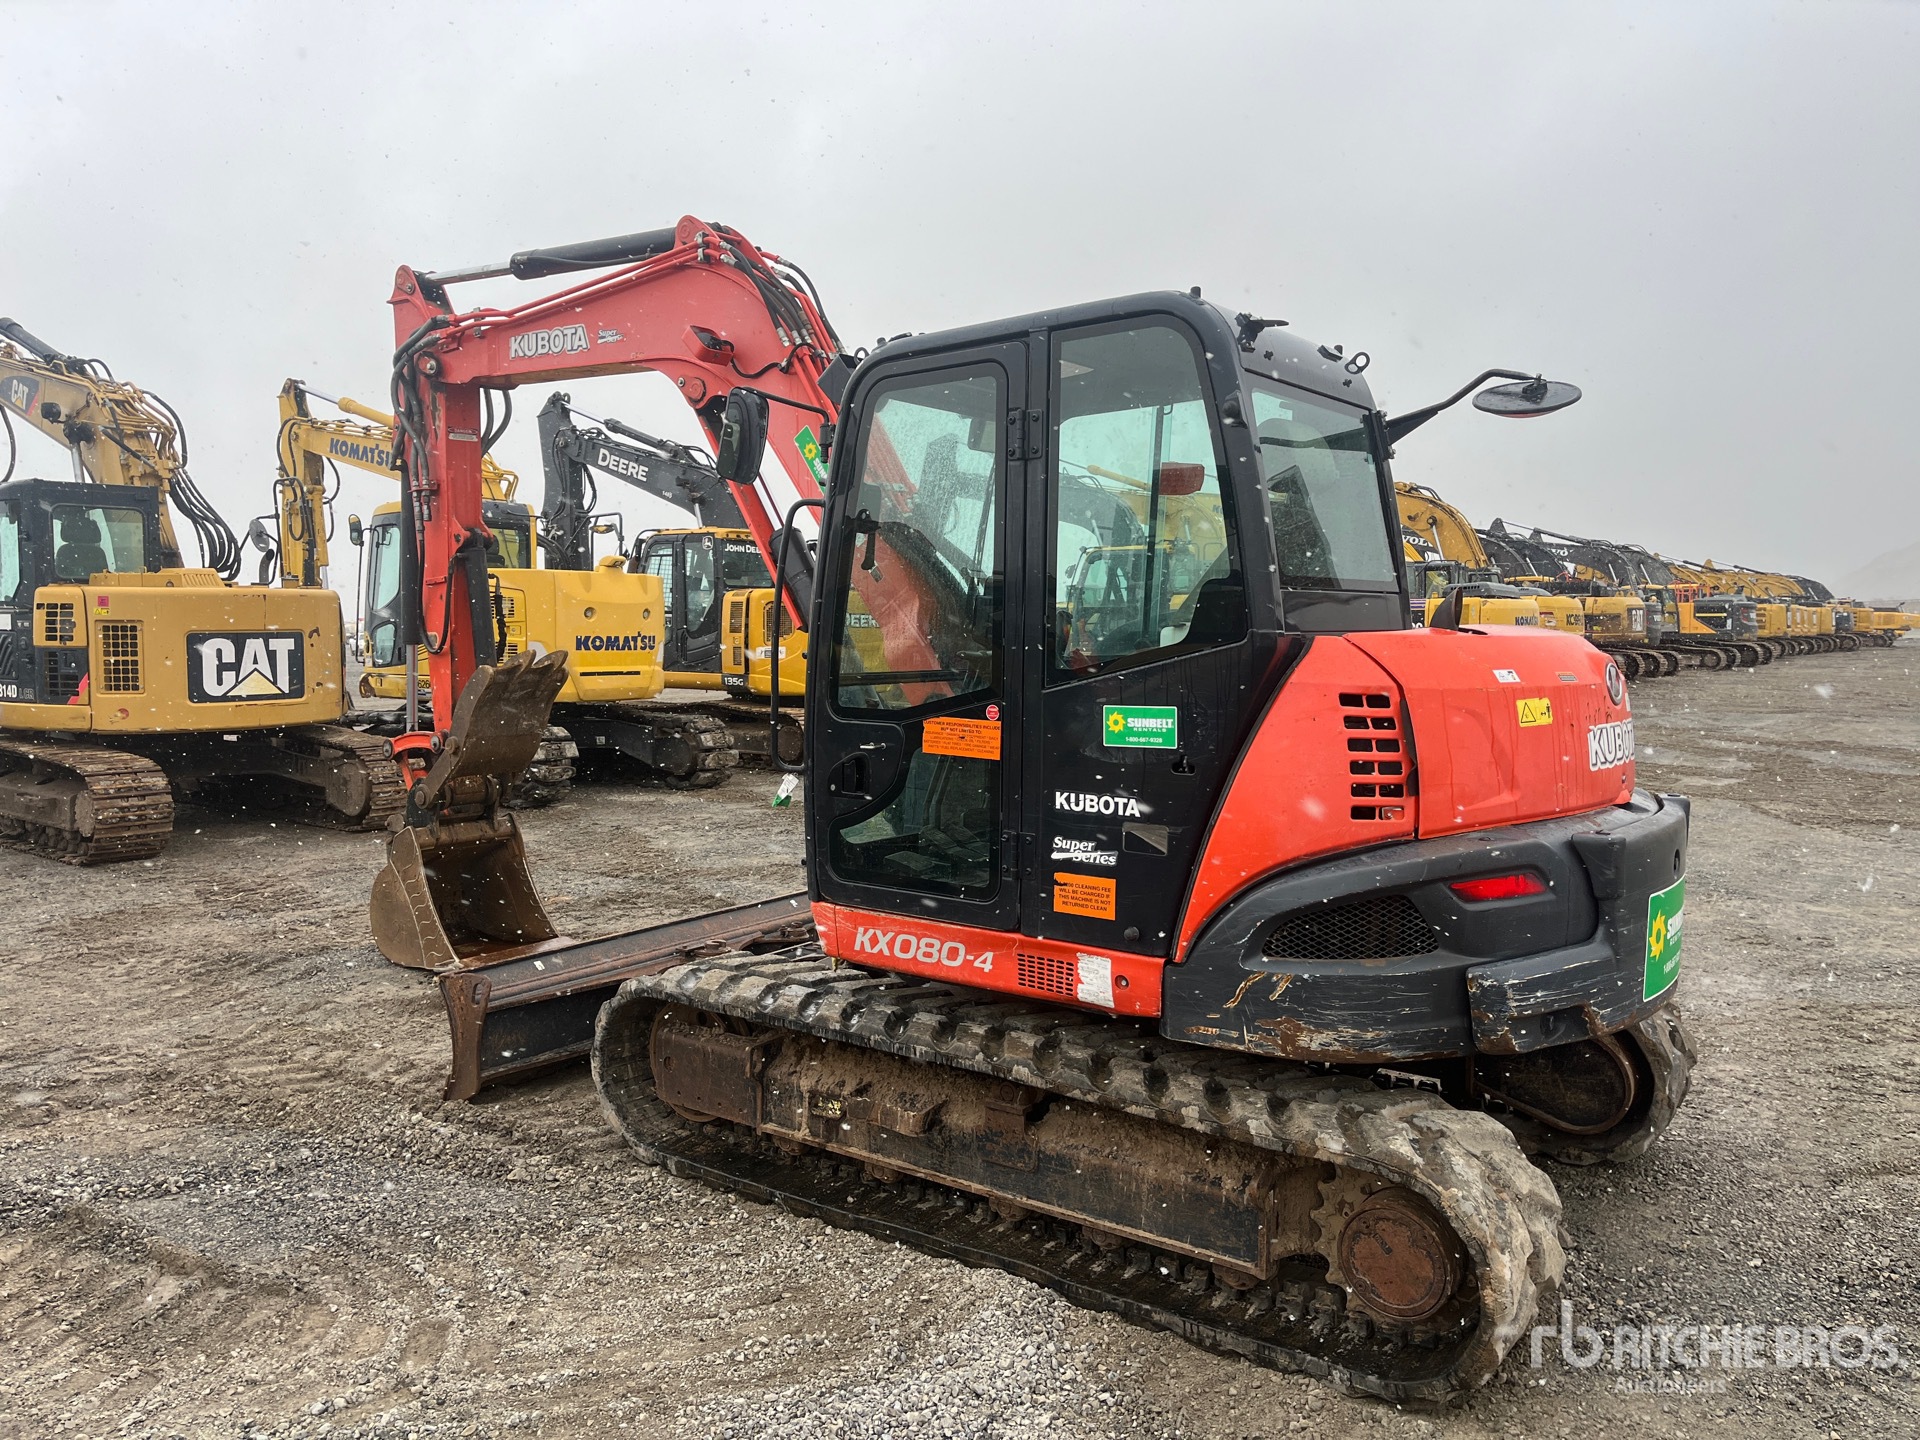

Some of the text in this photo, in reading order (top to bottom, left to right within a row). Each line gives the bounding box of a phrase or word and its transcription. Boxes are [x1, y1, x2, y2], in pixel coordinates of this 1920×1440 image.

[510, 325, 588, 359] KUBOTA
[11, 379, 29, 410] CAT
[598, 448, 649, 482] DEERE
[725, 543, 762, 554] JOHN DEE
[575, 631, 656, 651] KOMATSU
[202, 638, 295, 696] CAT
[724, 677, 744, 686] 135G
[1127, 718, 1174, 729] SUNBELT
[1588, 719, 1634, 770] KUBOT
[1055, 791, 1141, 818] KUBOTA
[1053, 836, 1097, 852] Super
[1072, 850, 1117, 866] Series
[1075, 883, 1101, 891] CLEANING
[1080, 890, 1105, 898] CHARGED
[1062, 901, 1089, 909] RETURNED
[854, 927, 994, 973] KX080-4
